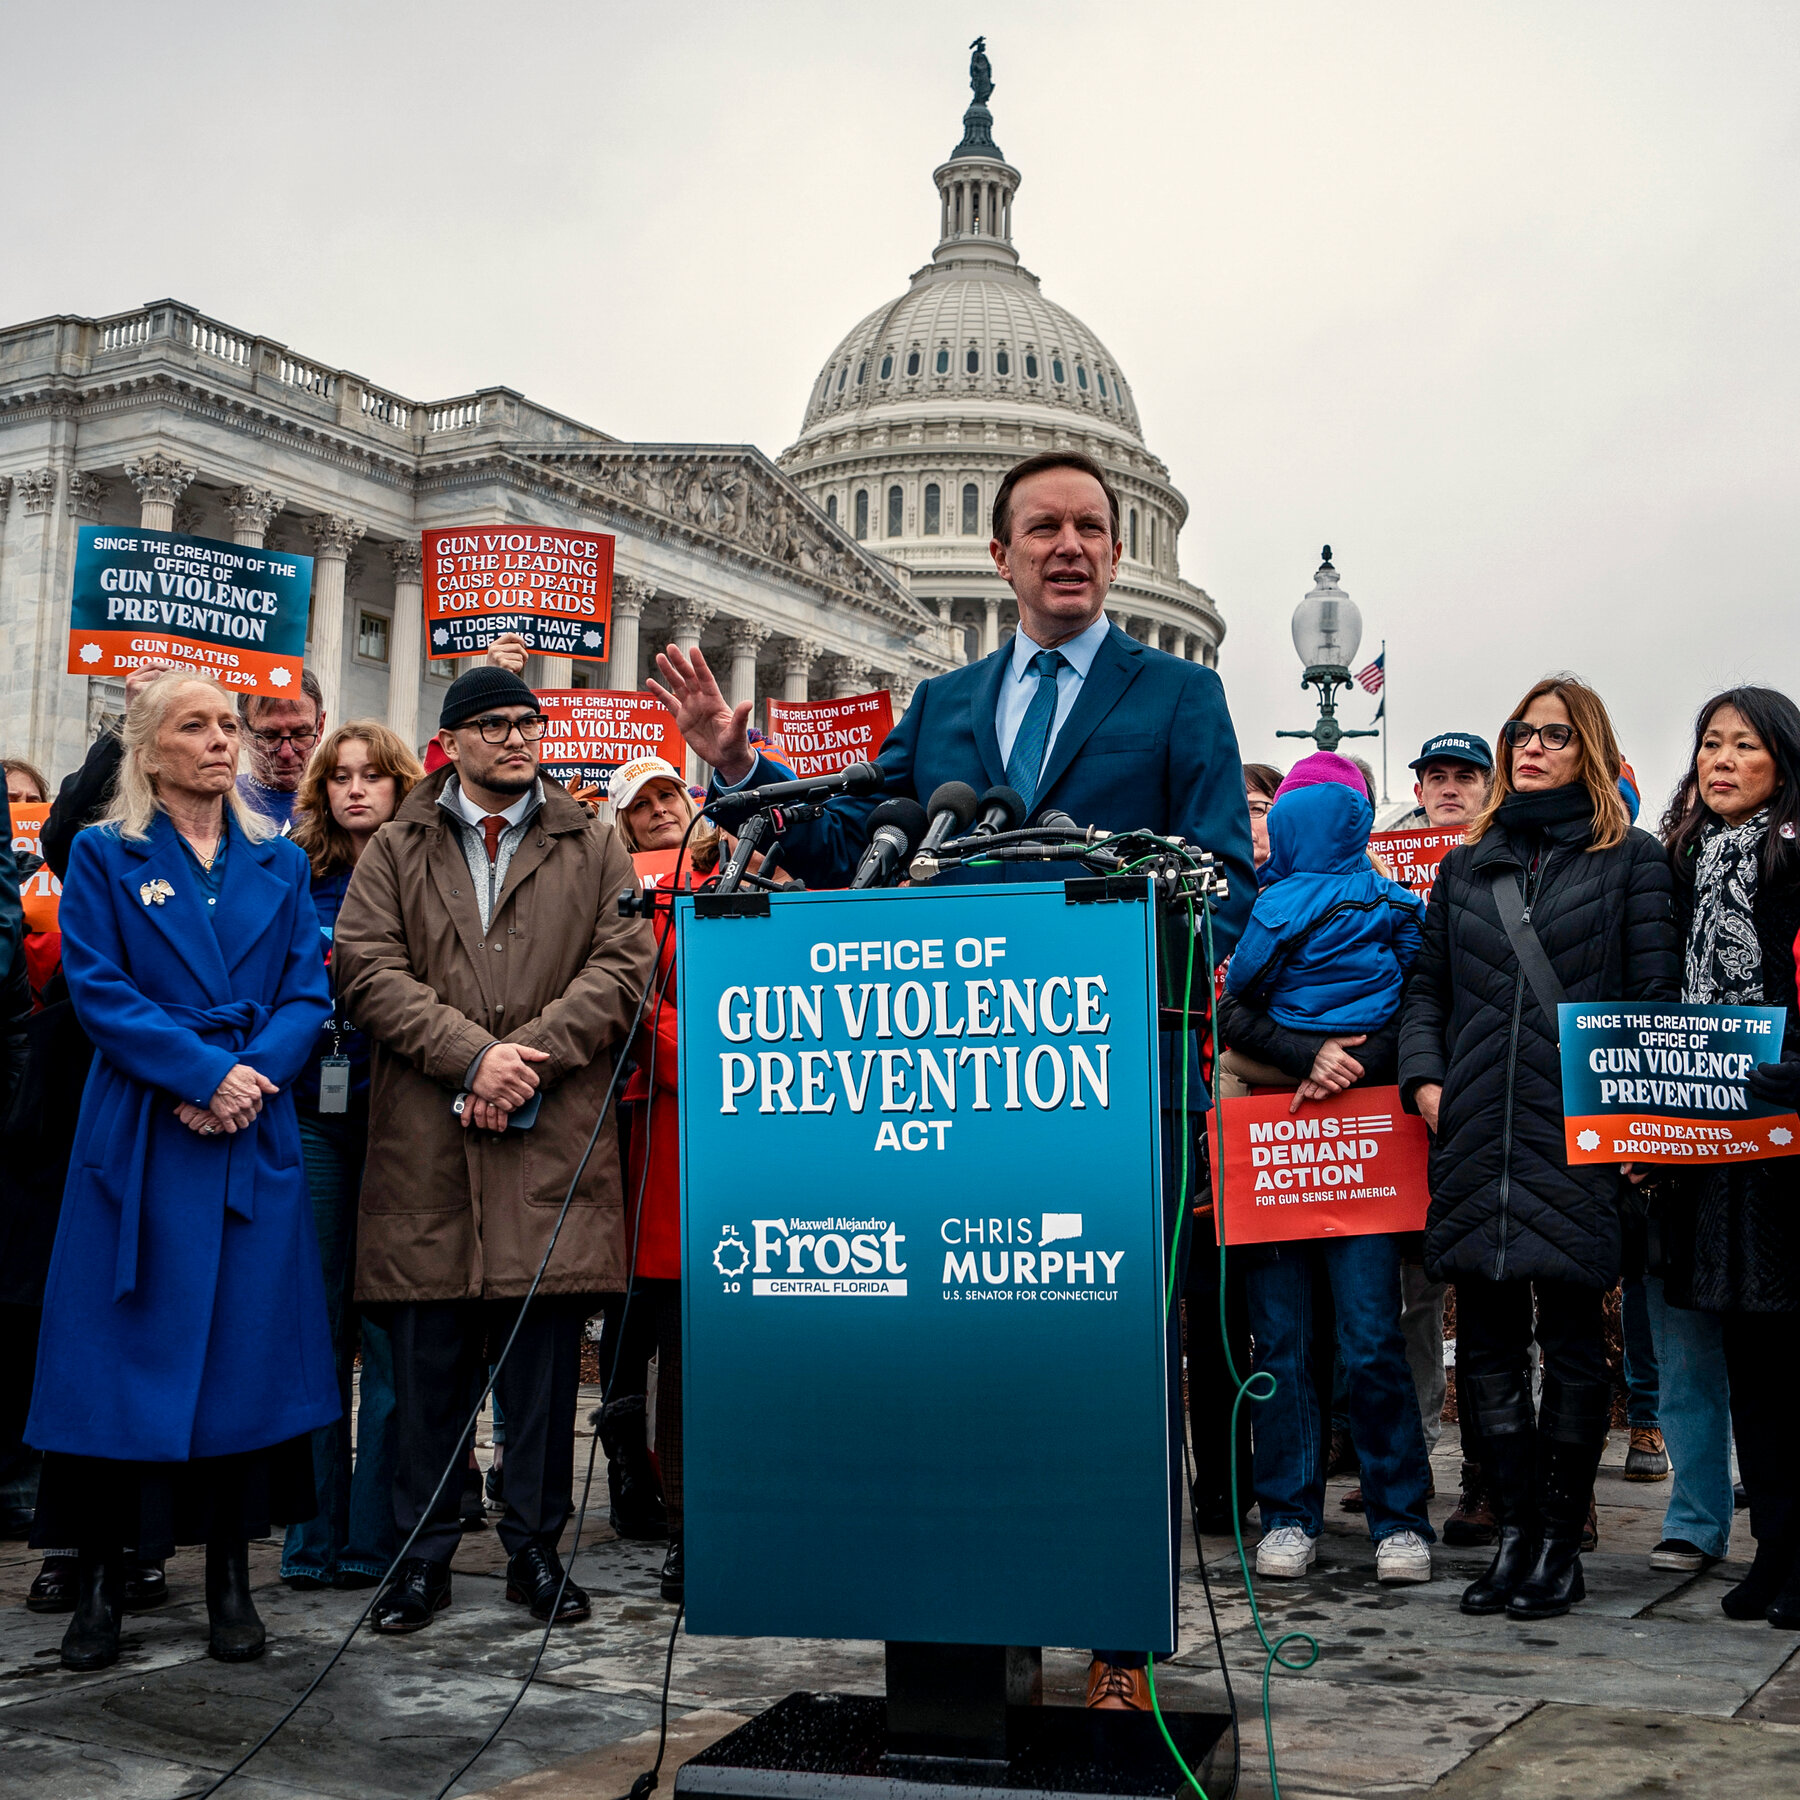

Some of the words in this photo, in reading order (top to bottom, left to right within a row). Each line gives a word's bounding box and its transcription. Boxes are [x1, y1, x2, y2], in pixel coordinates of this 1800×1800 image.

[94, 538, 137, 551] SINCE
[141, 540, 170, 555] THE
[174, 544, 243, 568] CREATION
[246, 559, 265, 572] OF
[268, 562, 296, 577] THE
[437, 535, 479, 556] GUN
[483, 535, 598, 560] VIOLENCE
[154, 558, 209, 578] OFFICE
[212, 567, 233, 582] OF
[437, 558, 455, 574] IS
[457, 554, 499, 572] THE
[504, 554, 597, 578] LEADING
[100, 568, 153, 593] GUN
[158, 573, 278, 616] VIOLENCE
[437, 573, 494, 592] CAUSE
[498, 572, 526, 587] OF
[530, 574, 596, 595] DEATH
[438, 592, 479, 613] FOR
[484, 590, 535, 608] OUR
[540, 591, 596, 615] KIDS
[107, 598, 266, 642] PREVENTION
[450, 621, 462, 634] IT
[466, 616, 533, 632] DOESN'T
[537, 619, 581, 636] HAVE
[131, 639, 168, 654] GUN
[171, 644, 239, 667] DEATHS
[453, 636, 473, 650] TO
[477, 634, 494, 648] BE
[540, 636, 577, 651] WAY
[200, 666, 224, 680] BY
[225, 670, 257, 686] 12%
[562, 697, 582, 706] THE
[585, 698, 638, 709] CREATION
[640, 700, 653, 710] OF
[790, 707, 839, 720] CREATION
[841, 705, 856, 715] OF
[858, 700, 879, 712] THE
[572, 709, 612, 719] OFFICE
[615, 710, 630, 720] OF
[576, 720, 664, 741] VIOLENCE
[784, 722, 814, 733] OFFICE
[817, 720, 833, 731] OF
[786, 725, 872, 752] VIOLENCE
[1431, 739, 1470, 750] GIFFORDS
[542, 742, 658, 760] PREVENTION
[548, 768, 581, 778] MASS
[1424, 836, 1439, 847] OF
[1442, 834, 1464, 846] THE
[1397, 852, 1414, 864] OF
[810, 939, 944, 972] OFFICE
[955, 937, 1006, 968] OF
[718, 984, 824, 1042] GUN
[834, 974, 1110, 1039] VIOLENCE
[1576, 1015, 1621, 1029] SINCE
[1624, 1015, 1651, 1028] THE
[1654, 1016, 1718, 1031] CREATION
[1722, 1018, 1741, 1033] OF
[1744, 1020, 1771, 1034] THE
[1638, 1032, 1686, 1048] OFFICE
[1690, 1034, 1708, 1049] OF
[1589, 1048, 1640, 1073] GUN
[719, 1044, 1110, 1115] PREVENTION
[1600, 1079, 1748, 1111] PREVENTION
[874, 1121, 952, 1151] ACT
[1250, 1118, 1340, 1143] MOMS
[1629, 1122, 1661, 1137] GUN
[1664, 1124, 1733, 1140] DEATHS
[1251, 1139, 1378, 1167] DEMAND
[1613, 1140, 1693, 1156] DROPPED
[1696, 1144, 1719, 1156] BY
[1723, 1141, 1759, 1155] 12%
[1254, 1164, 1364, 1191] ACTION
[1256, 1196, 1276, 1206] FOR
[1279, 1194, 1299, 1204] GUN
[1302, 1192, 1334, 1203] SENSE
[1336, 1191, 1347, 1200] IN
[1350, 1186, 1396, 1199] AMERICA
[722, 1225, 739, 1235] FL
[790, 1218, 834, 1230] Maxwell
[835, 1217, 887, 1233] Alejandro
[941, 1218, 1033, 1244] CHRIS
[752, 1218, 907, 1275] Frost
[942, 1251, 1125, 1284] MURPHY
[723, 1282, 740, 1293] 10
[771, 1282, 830, 1292] CENTRAL
[834, 1282, 889, 1292] FLORIDA
[943, 1290, 962, 1300] U.S.
[965, 1290, 1013, 1300] SENATOR
[1016, 1290, 1037, 1300] FOR
[1040, 1290, 1118, 1300] CONNECTICUT
